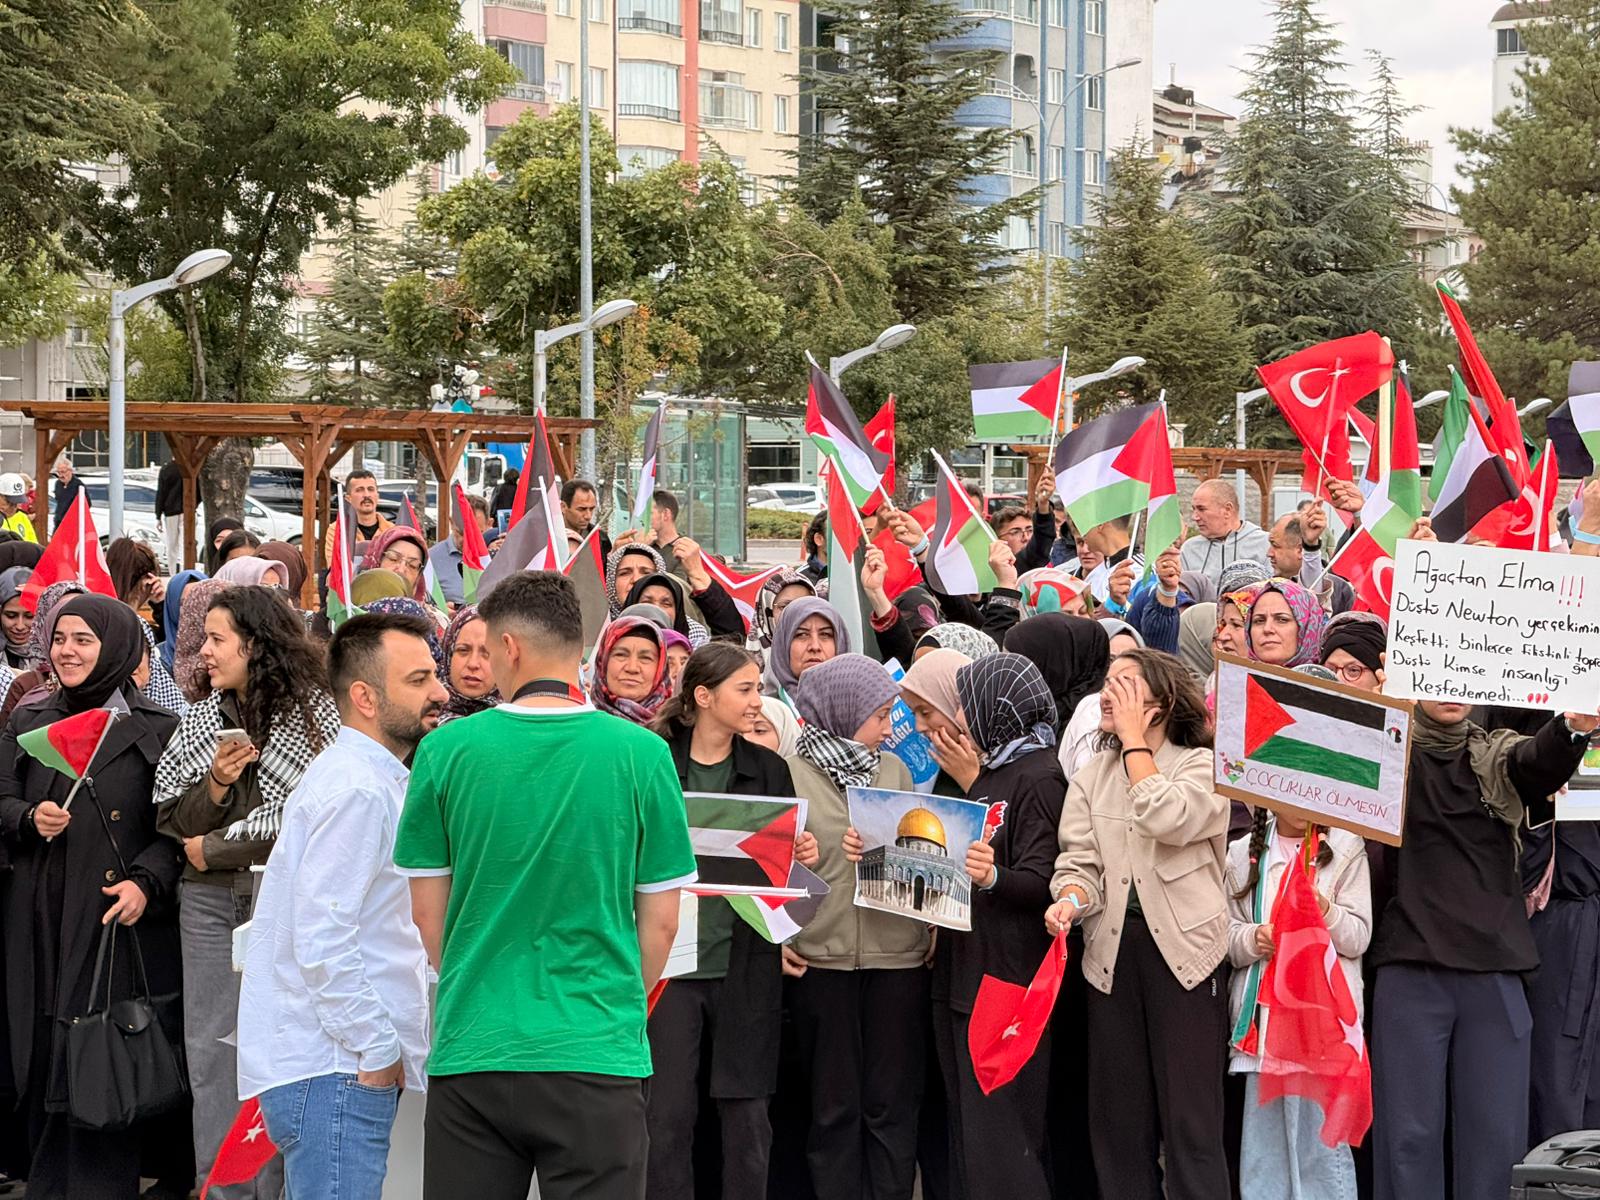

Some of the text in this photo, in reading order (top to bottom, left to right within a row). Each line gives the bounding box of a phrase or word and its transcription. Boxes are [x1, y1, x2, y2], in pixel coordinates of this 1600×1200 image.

[1413, 550, 1486, 593] Ağaçtan
[1446, 598, 1519, 627] Newton
[1458, 632, 1513, 655] binlerce
[1444, 653, 1486, 676] Kimse
[1246, 768, 1322, 801] ÇOCUKLAR
